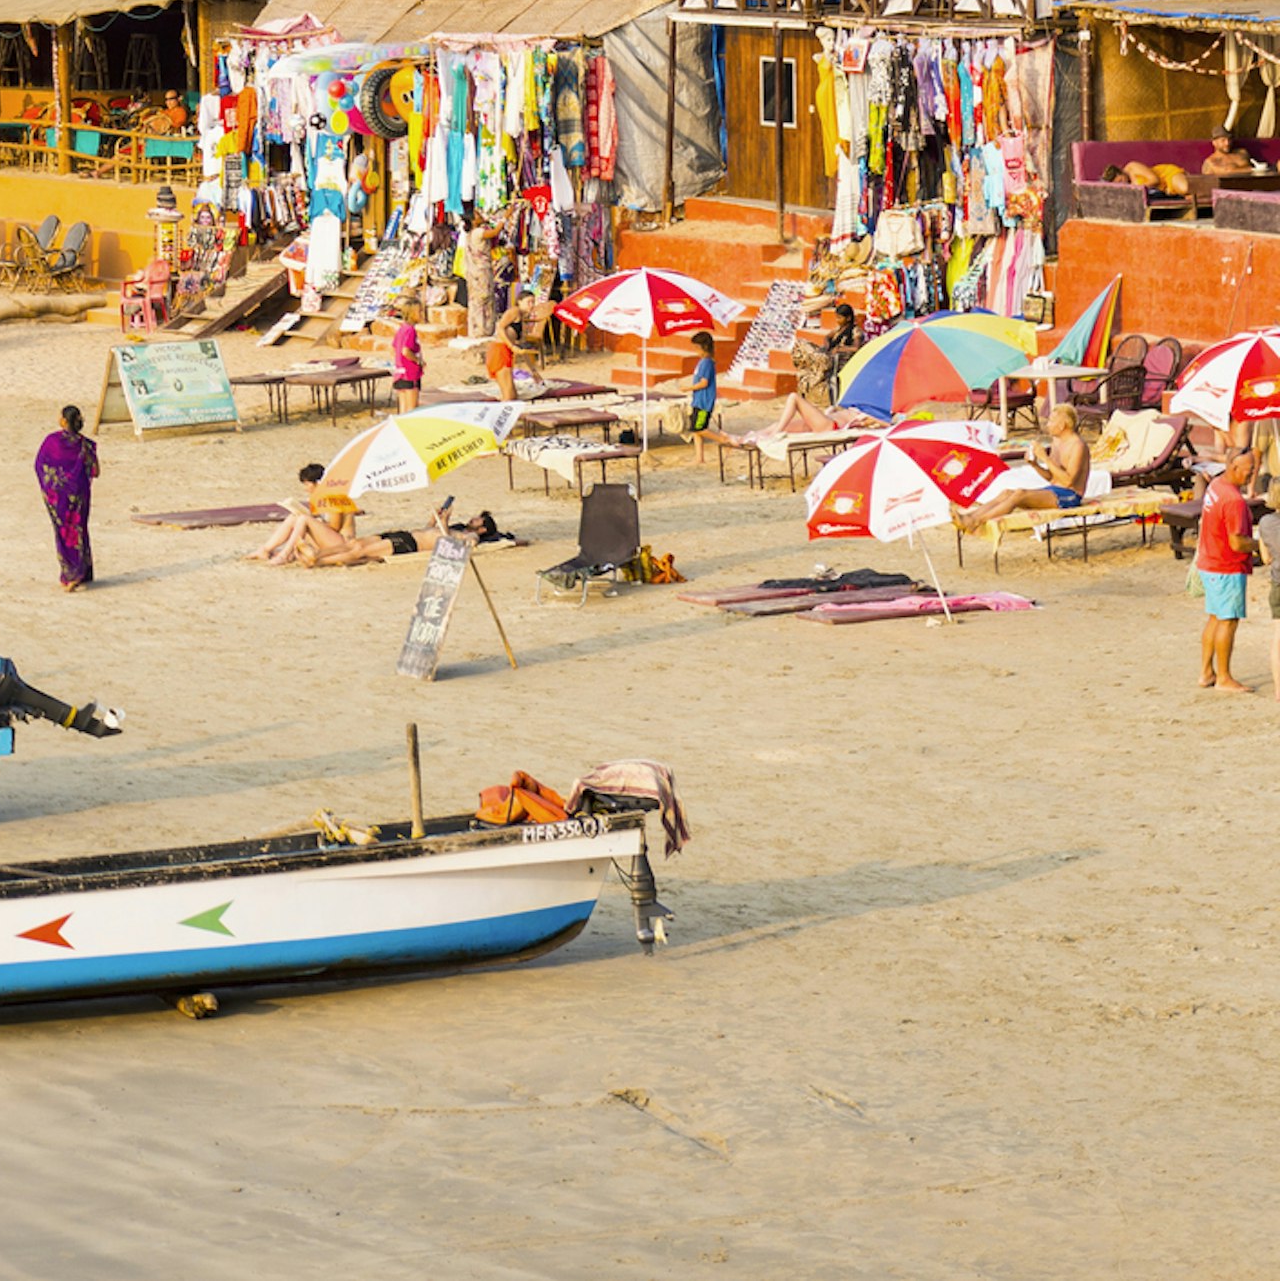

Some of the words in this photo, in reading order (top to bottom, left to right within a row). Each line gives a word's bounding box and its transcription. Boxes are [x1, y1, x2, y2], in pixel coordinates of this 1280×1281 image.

[436, 457, 448, 470] BE
[448, 437, 485, 465] FRESHED
[375, 472, 417, 490] FRESHED
